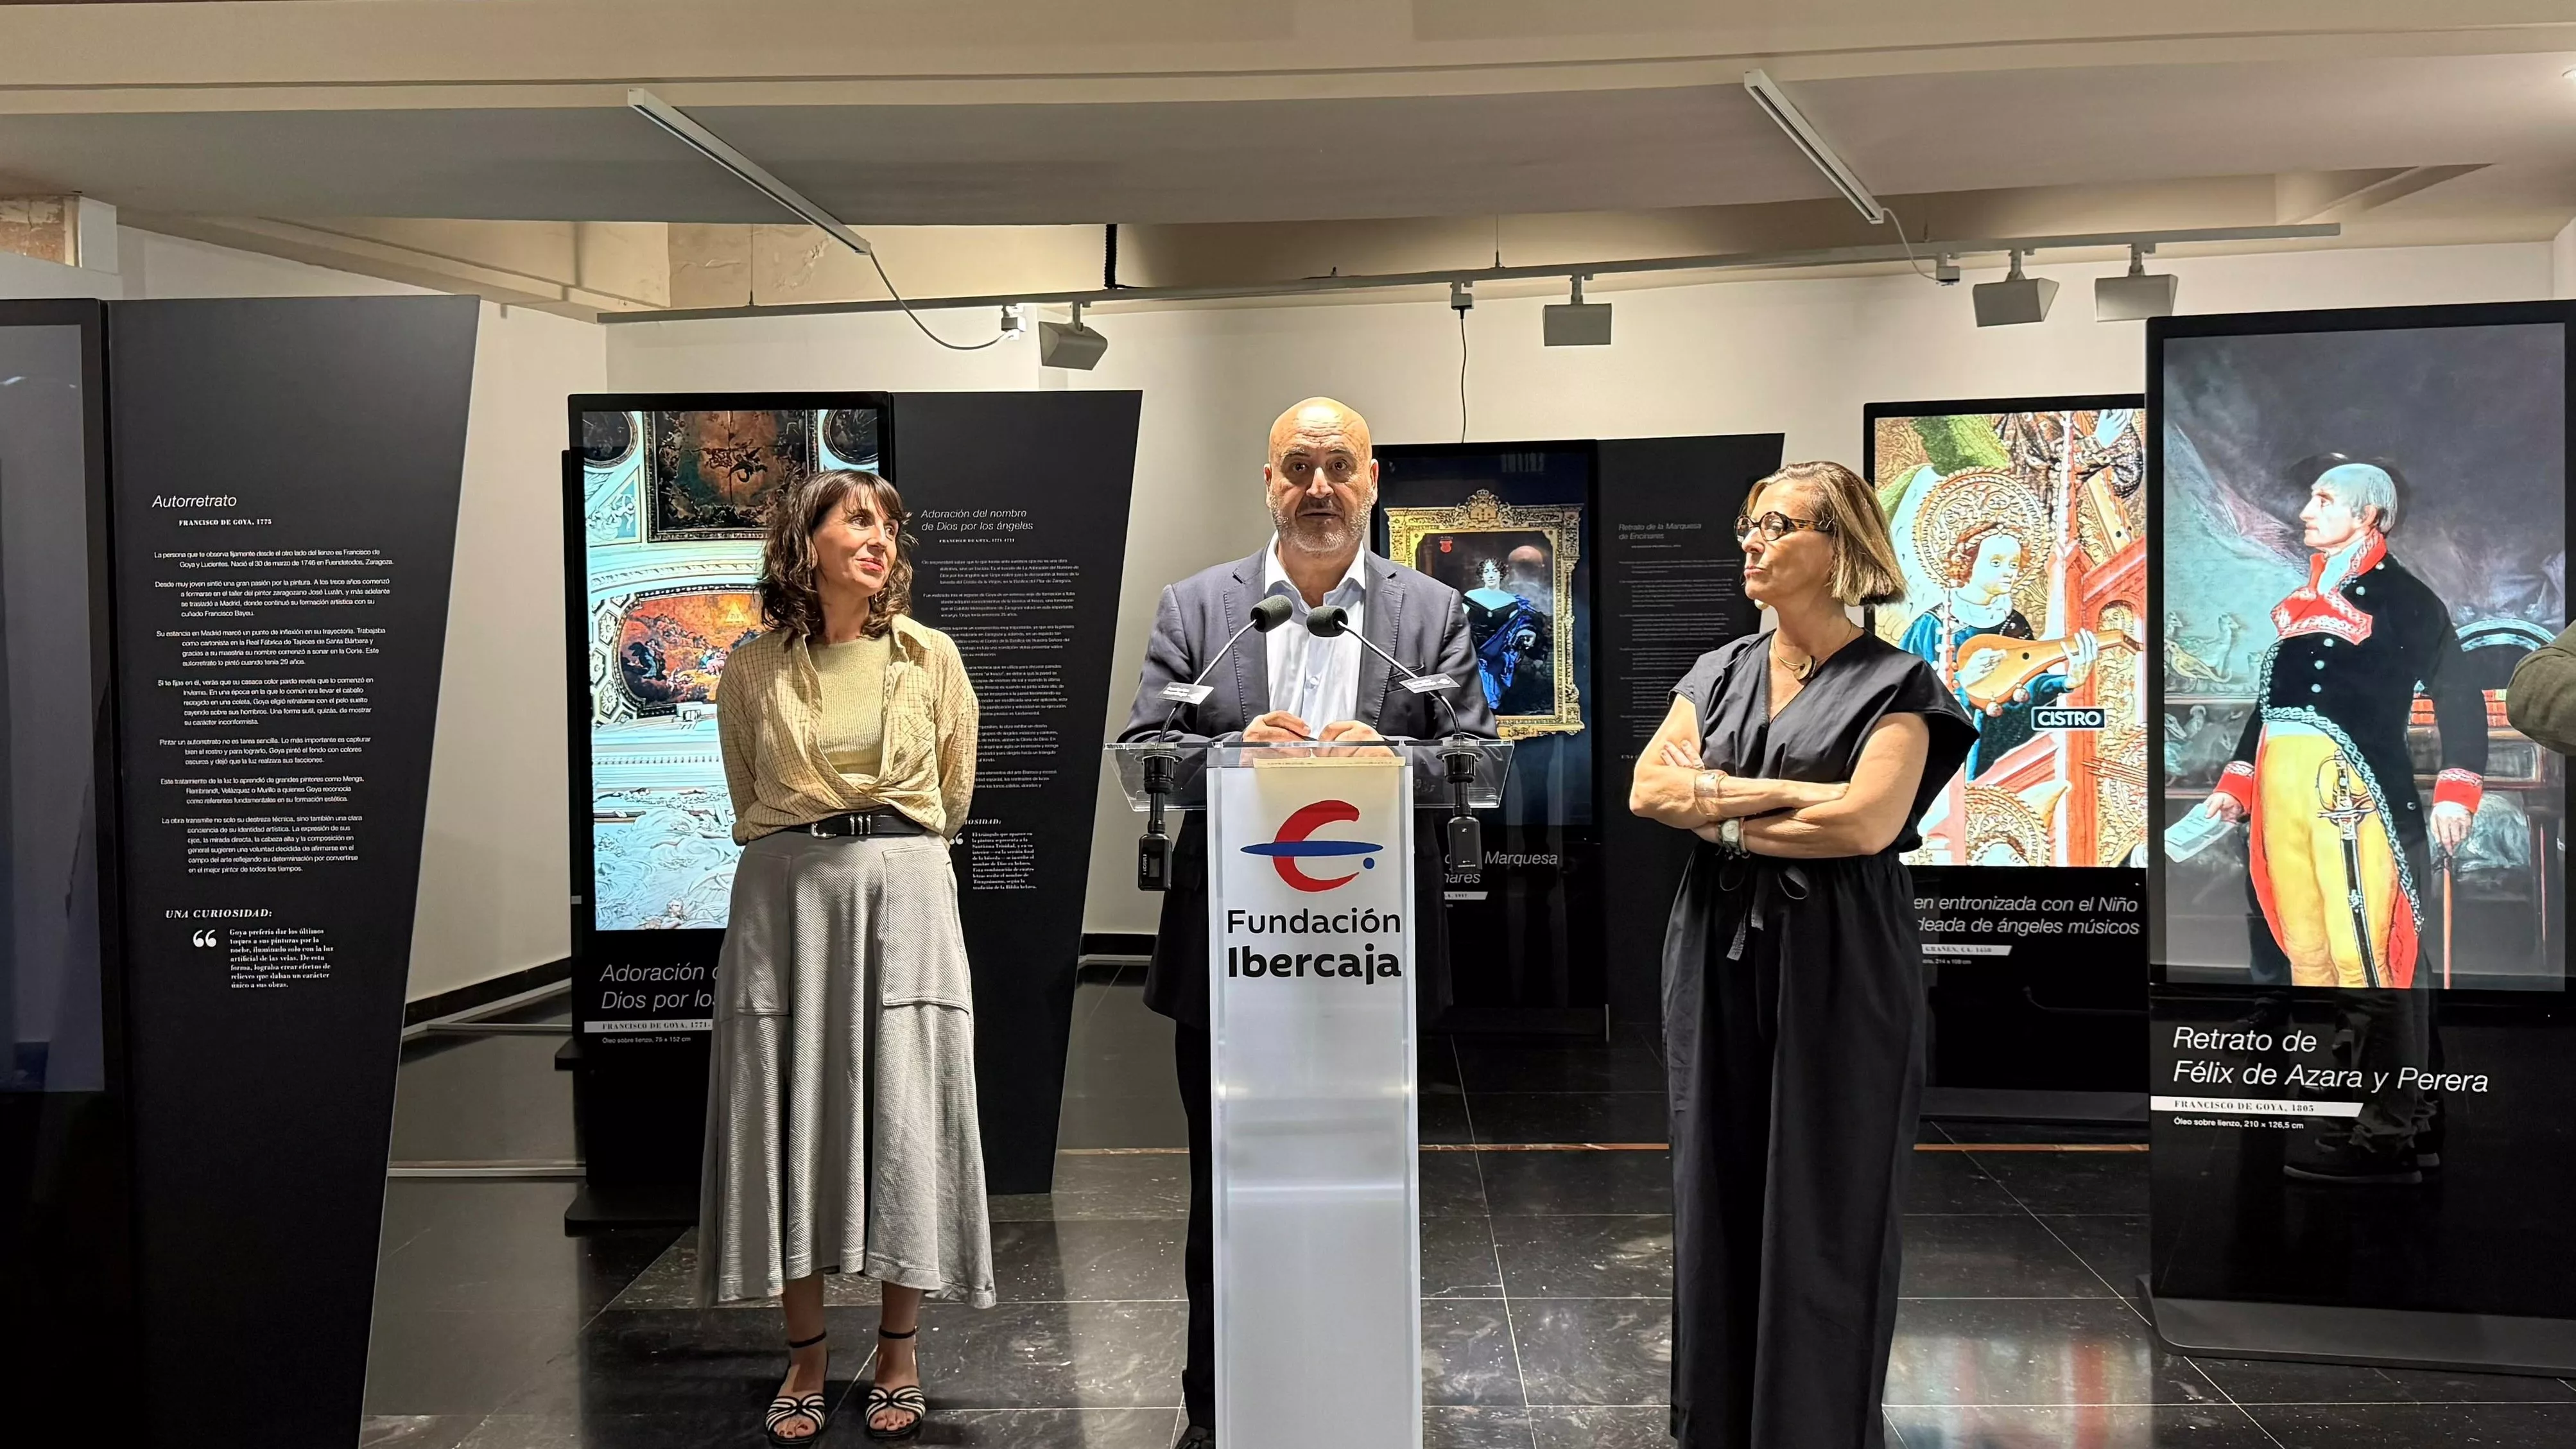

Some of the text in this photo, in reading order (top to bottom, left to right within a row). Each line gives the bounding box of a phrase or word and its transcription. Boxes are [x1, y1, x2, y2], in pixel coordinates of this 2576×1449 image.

[151, 495, 237, 507] Autorretrato
[921, 509, 1027, 518] Adoración del nombre
[921, 521, 1033, 532] de Dios por los ángeles
[2037, 711, 2102, 726] CISTRO
[1485, 851, 1558, 866] Marquesa
[1939, 896, 2037, 911] entronizada
[2041, 899, 2074, 911] con
[2079, 897, 2095, 912] el
[2098, 897, 2138, 912] Niño
[166, 909, 272, 918] UNA CURIOSIDAD:
[1228, 908, 1400, 933] Fundación
[1971, 917, 1993, 932] de
[1997, 918, 2064, 936] ángeles
[2068, 919, 2140, 934] músicos
[600, 962, 704, 982] Adoración
[1229, 944, 1401, 985] Ibercaja
[601, 989, 715, 1012] Dios por lo
[2173, 1027, 2317, 1052] Retrato de
[2174, 1060, 2488, 1093] Félix de Azara y Perera
[2174, 1100, 2315, 1113] FRANCISCO DE GOYA, 1805
[2174, 1116, 2193, 1125] Óleo
[2217, 1119, 2242, 1127] lienzo,
